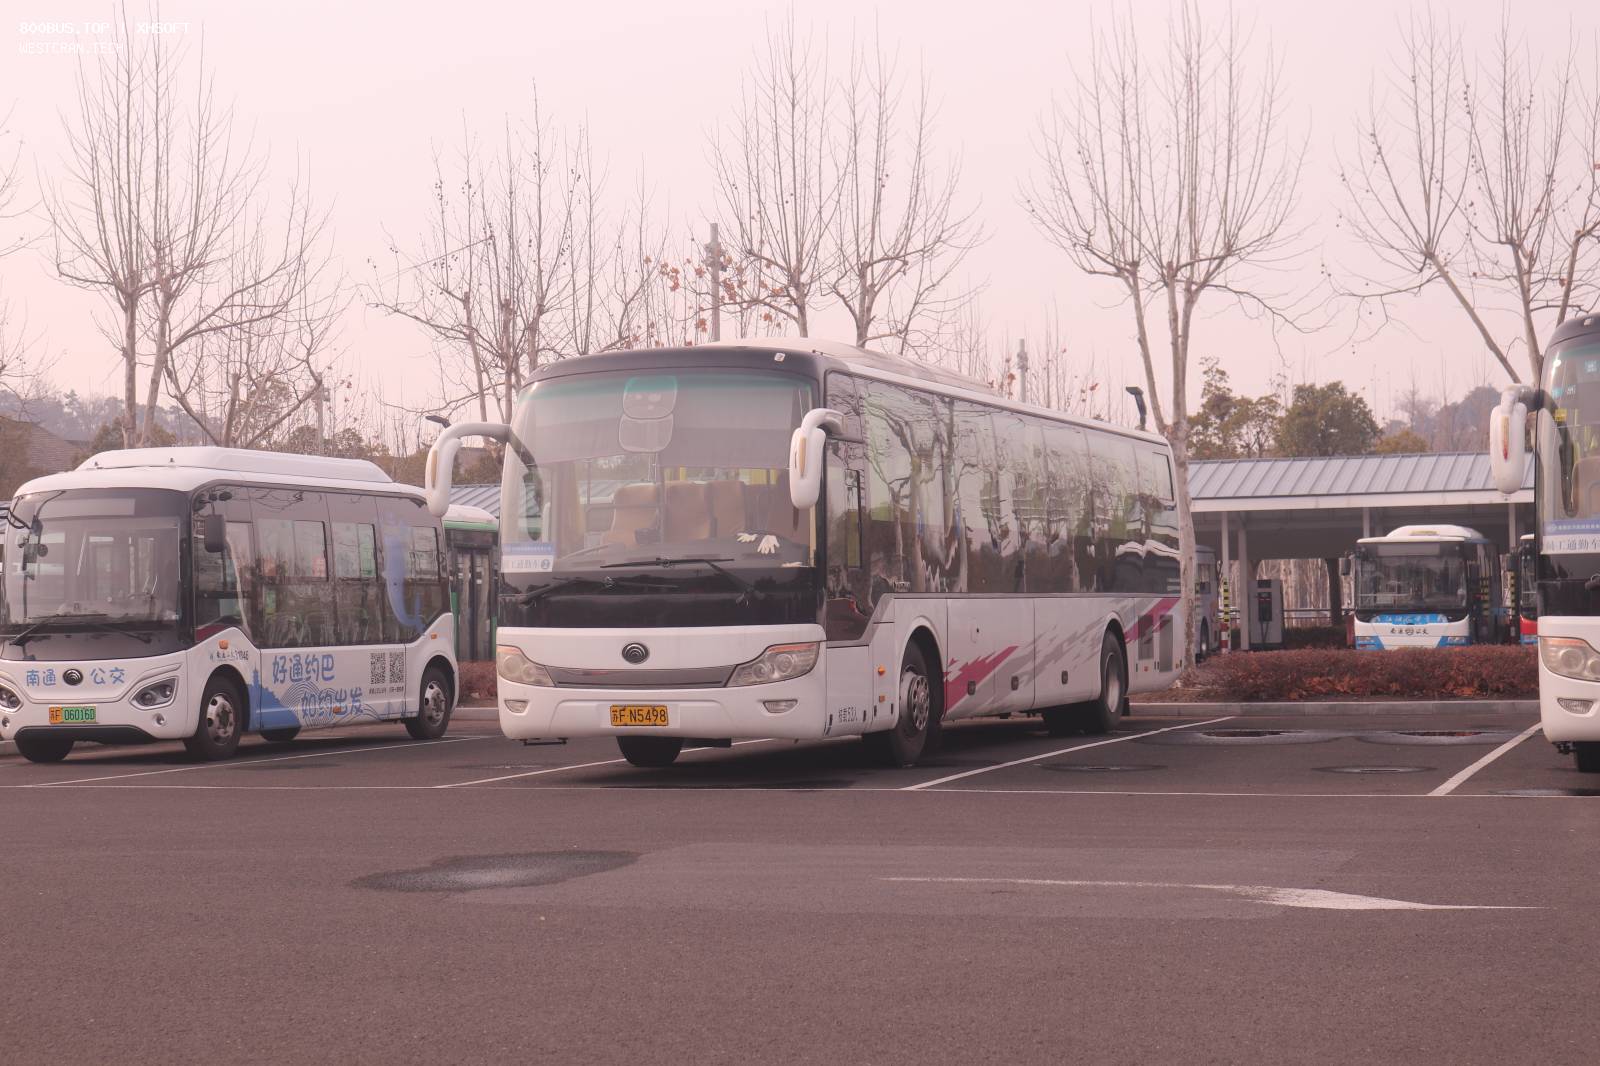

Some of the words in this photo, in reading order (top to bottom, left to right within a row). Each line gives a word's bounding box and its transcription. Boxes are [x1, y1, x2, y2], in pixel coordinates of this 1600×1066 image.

[26, 669, 56, 686] 南通
[90, 667, 125, 684] 公交
[272, 654, 335, 684] 好通约巴
[302, 687, 363, 718] 如约出发
